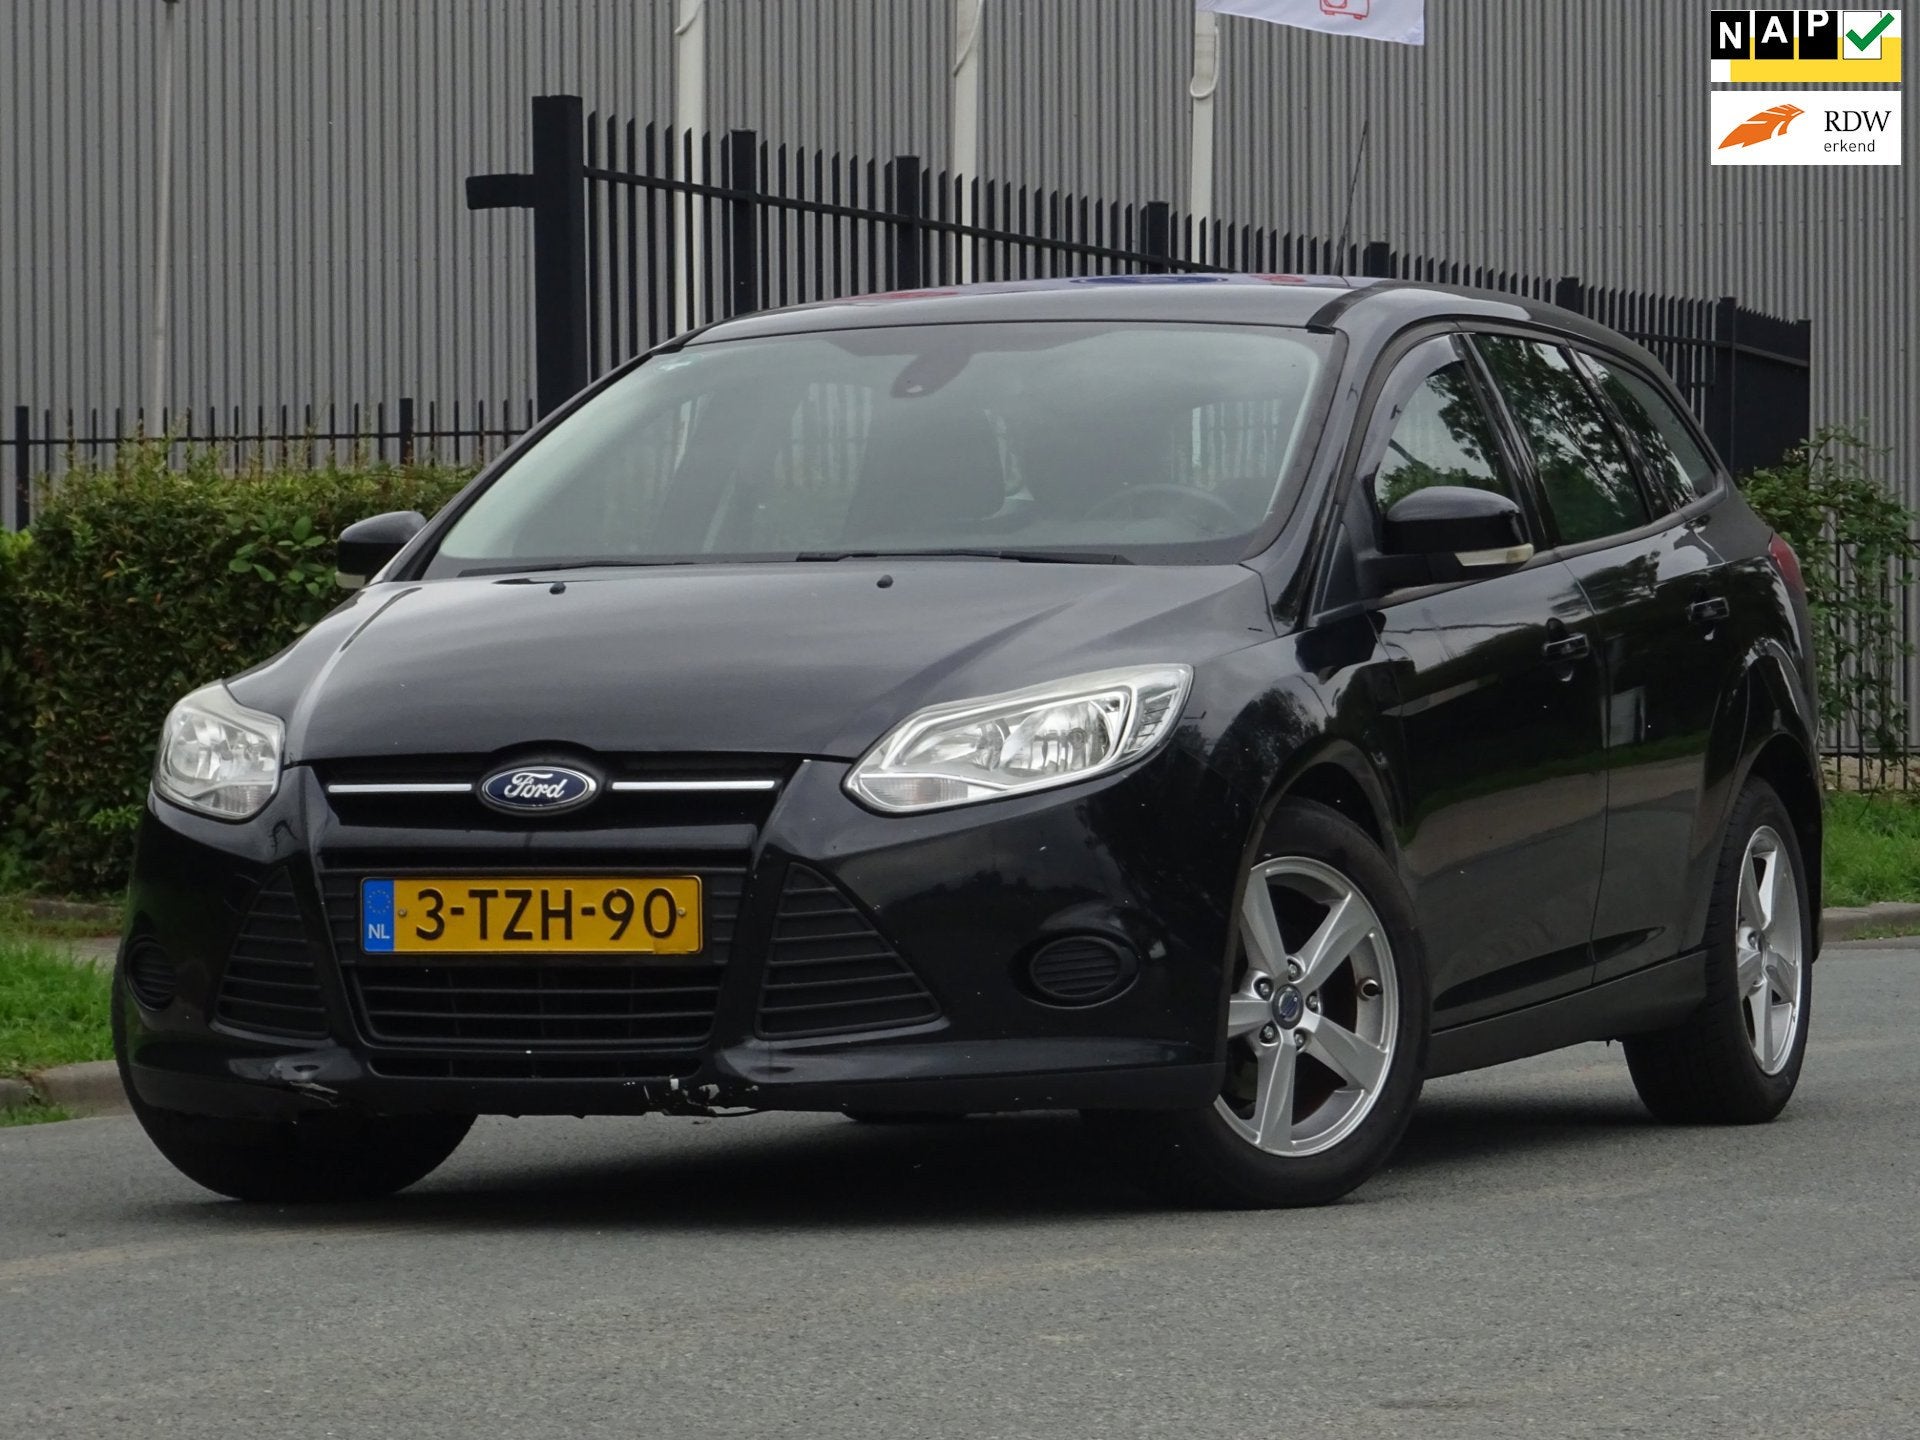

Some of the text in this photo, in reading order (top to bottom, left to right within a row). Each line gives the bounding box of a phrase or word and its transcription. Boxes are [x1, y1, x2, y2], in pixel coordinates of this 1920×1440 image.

[504, 772, 566, 799] Ford
[368, 888, 677, 940] NL 3-TZH-90
